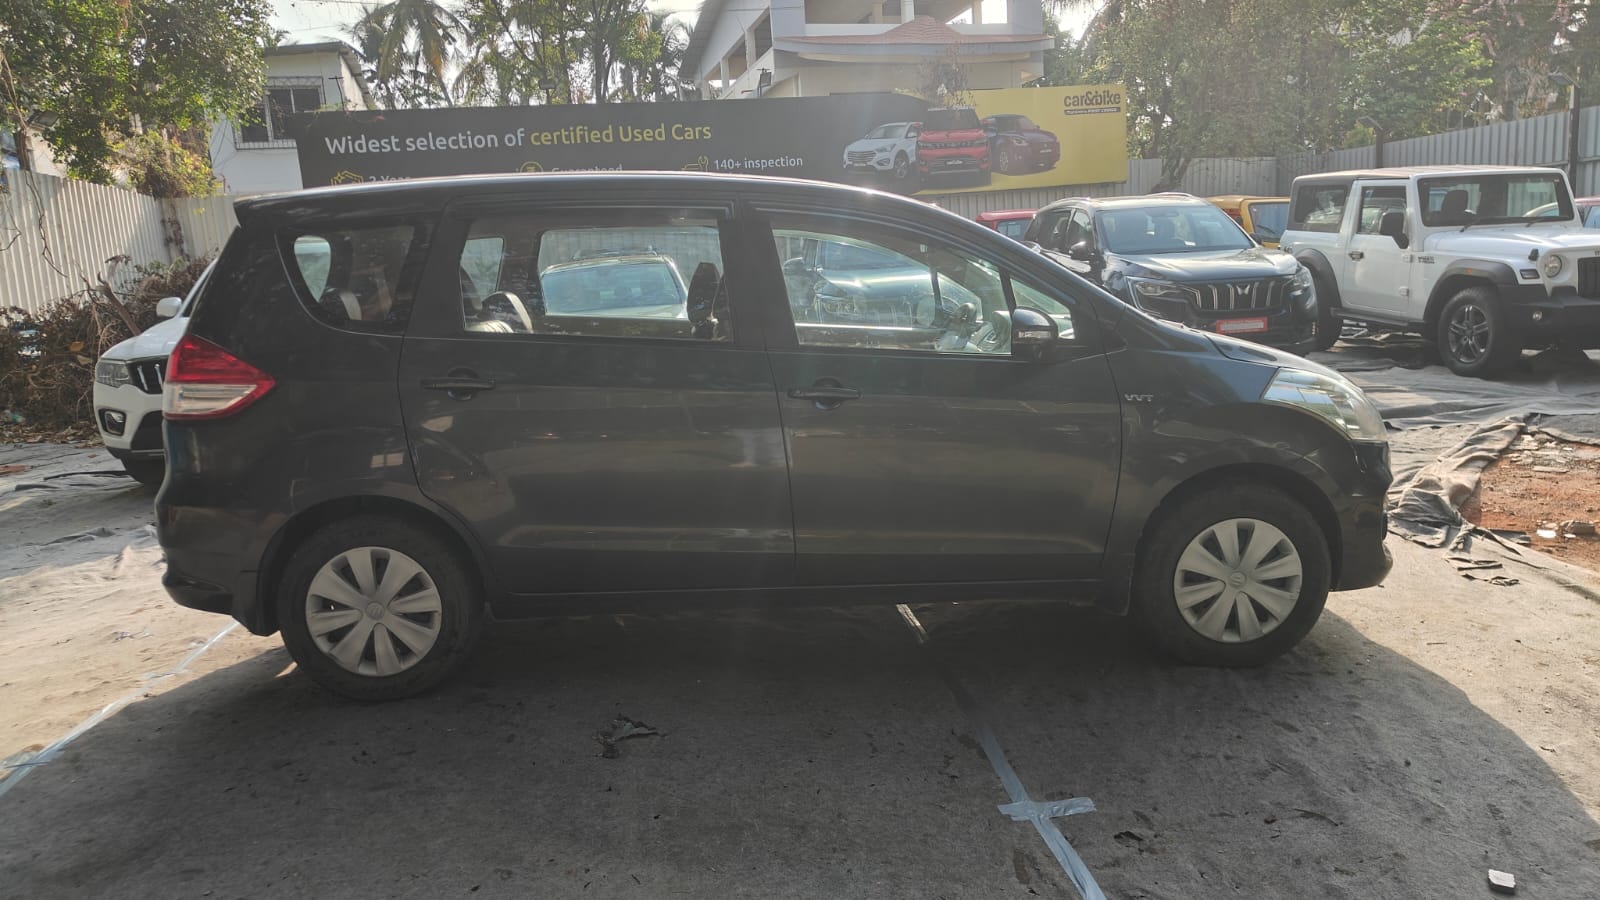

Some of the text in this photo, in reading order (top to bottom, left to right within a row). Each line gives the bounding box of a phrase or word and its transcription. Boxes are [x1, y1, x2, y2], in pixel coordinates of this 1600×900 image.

[1063, 90, 1121, 107] car&bike
[324, 123, 712, 154] Widest selection of certified Used Cars
[713, 155, 803, 171] 140+ inspection
